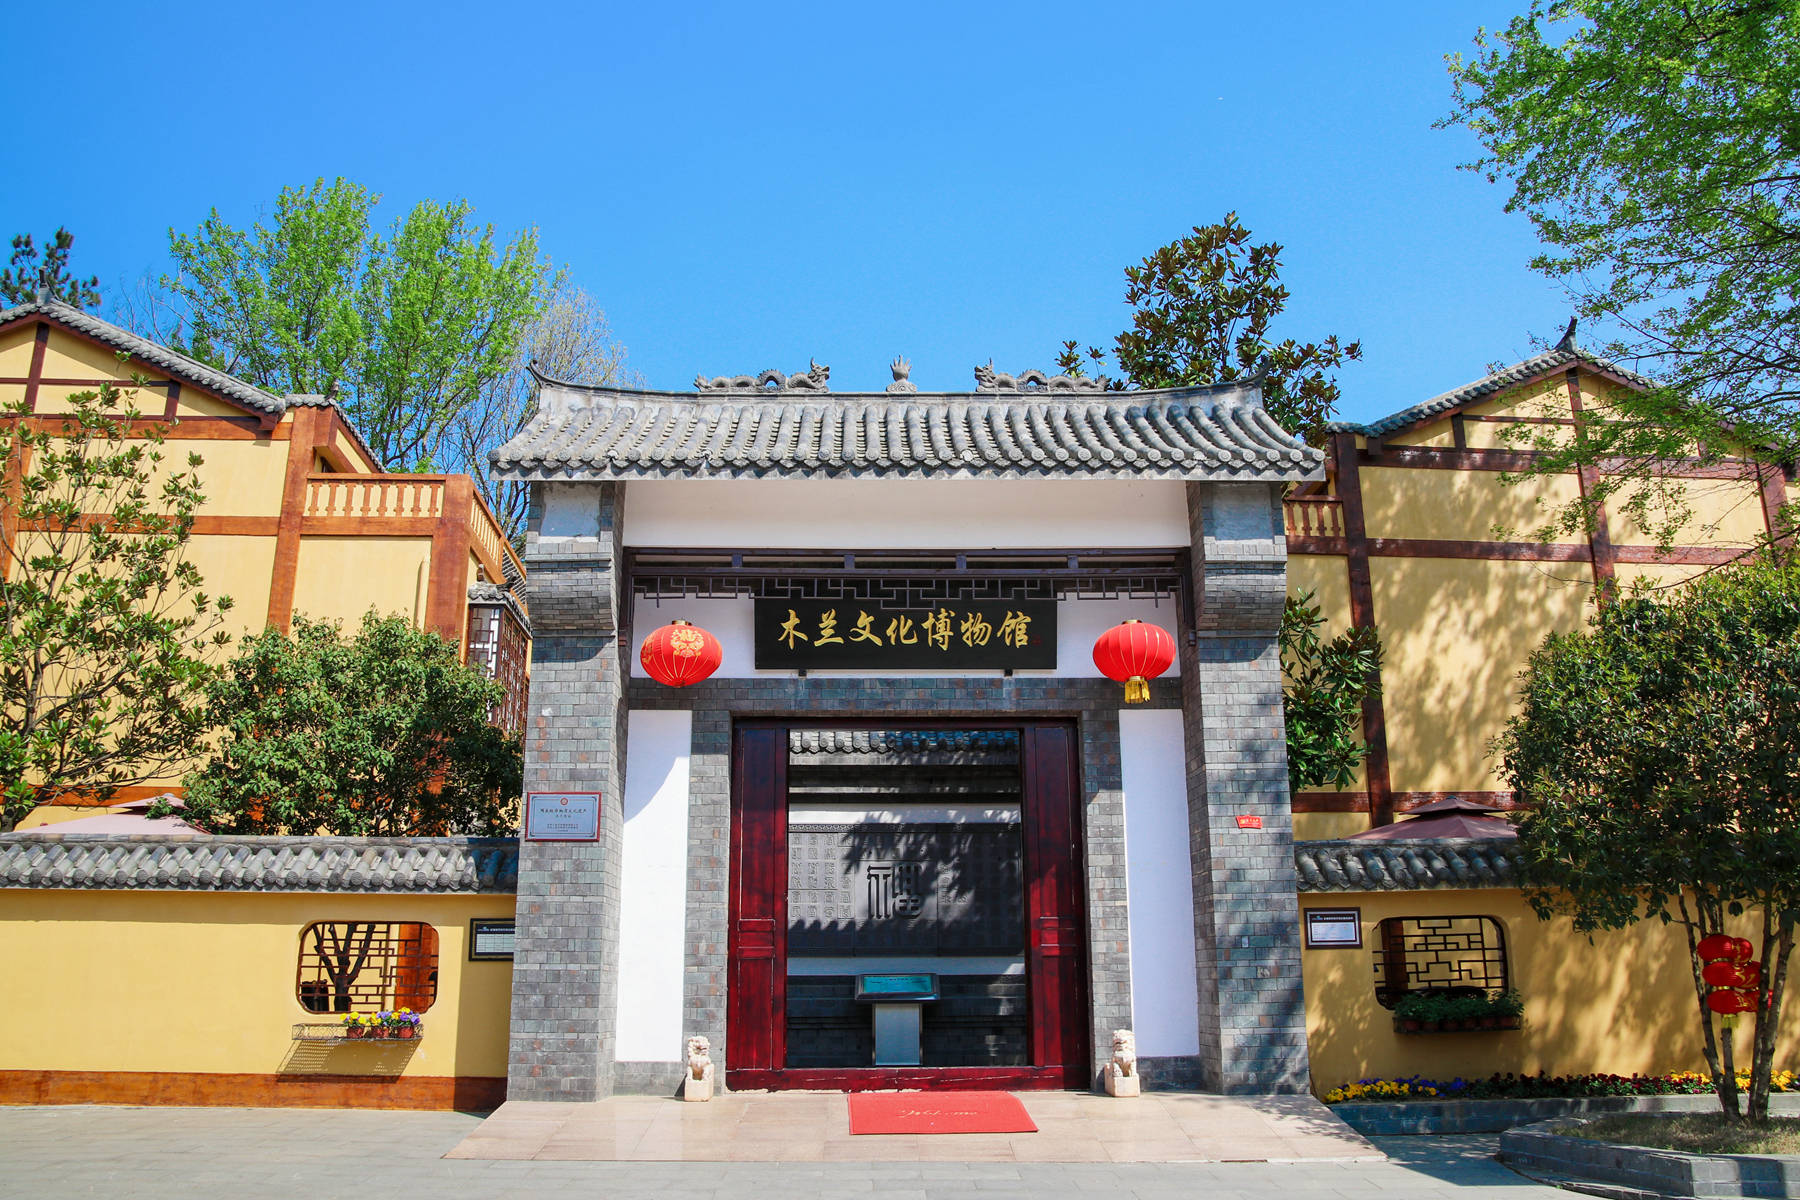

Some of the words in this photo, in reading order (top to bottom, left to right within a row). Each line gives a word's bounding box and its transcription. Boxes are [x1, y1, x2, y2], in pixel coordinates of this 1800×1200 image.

[778, 608, 1032, 650] 木兰文化博物馆
